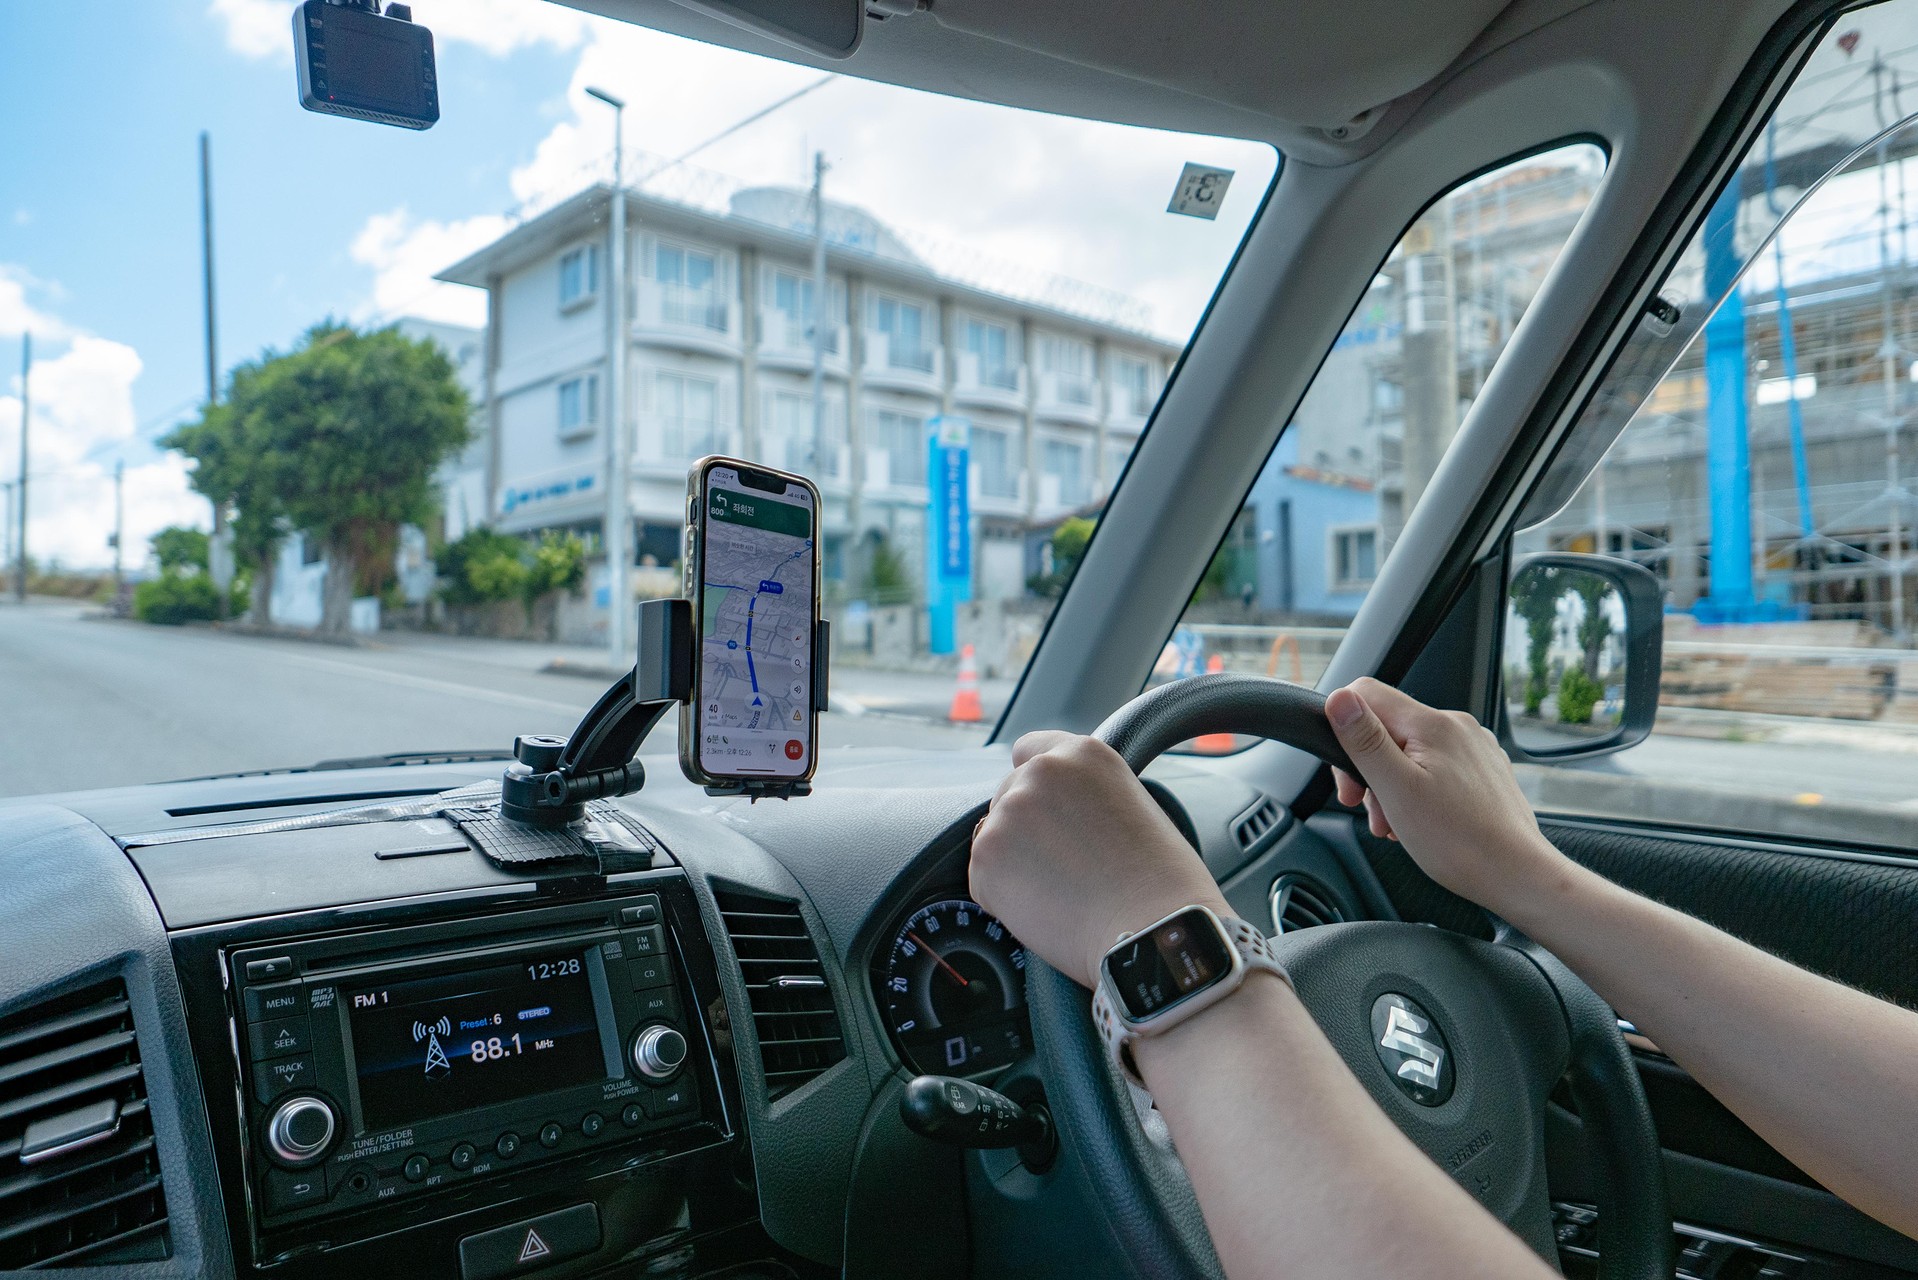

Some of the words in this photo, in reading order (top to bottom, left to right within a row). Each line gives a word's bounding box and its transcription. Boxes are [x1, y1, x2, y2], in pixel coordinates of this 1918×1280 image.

[710, 507, 724, 516] 800
[732, 503, 755, 516] 좌회전
[708, 704, 718, 713] 40
[956, 911, 970, 927] 80
[924, 916, 940, 934] 60
[985, 921, 1003, 942] 100
[638, 943, 650, 951] AM
[901, 940, 917, 957] 40
[528, 959, 580, 980] 12:28
[644, 970, 655, 978] CD
[893, 976, 907, 993] 20
[312, 987, 333, 995] MP3
[266, 997, 295, 1009] MENU
[354, 993, 376, 1008] FM
[381, 991, 388, 1003] 1
[648, 1000, 664, 1008] AUX
[518, 1006, 551, 1020] STEREO
[901, 1019, 915, 1030] 0
[274, 1037, 297, 1049] SEEK
[471, 1032, 523, 1063] 88.1
[535, 1039, 554, 1050] MHz
[274, 1062, 304, 1075] TRACK
[602, 1080, 632, 1092] VOLUME
[617, 1086, 640, 1097] POWER
[982, 1104, 991, 1114] OFF
[631, 1111, 638, 1120] 6
[592, 1121, 598, 1130] 5
[550, 1132, 557, 1141] 4
[337, 1153, 354, 1162] PUSH
[354, 1138, 414, 1158] ENTER/SETTING
[507, 1142, 514, 1151] 3
[462, 1152, 469, 1163] 2
[415, 1164, 421, 1174] 1
[473, 1164, 491, 1174] RDM
[426, 1175, 442, 1186] RPT
[378, 1187, 396, 1198] AUX
